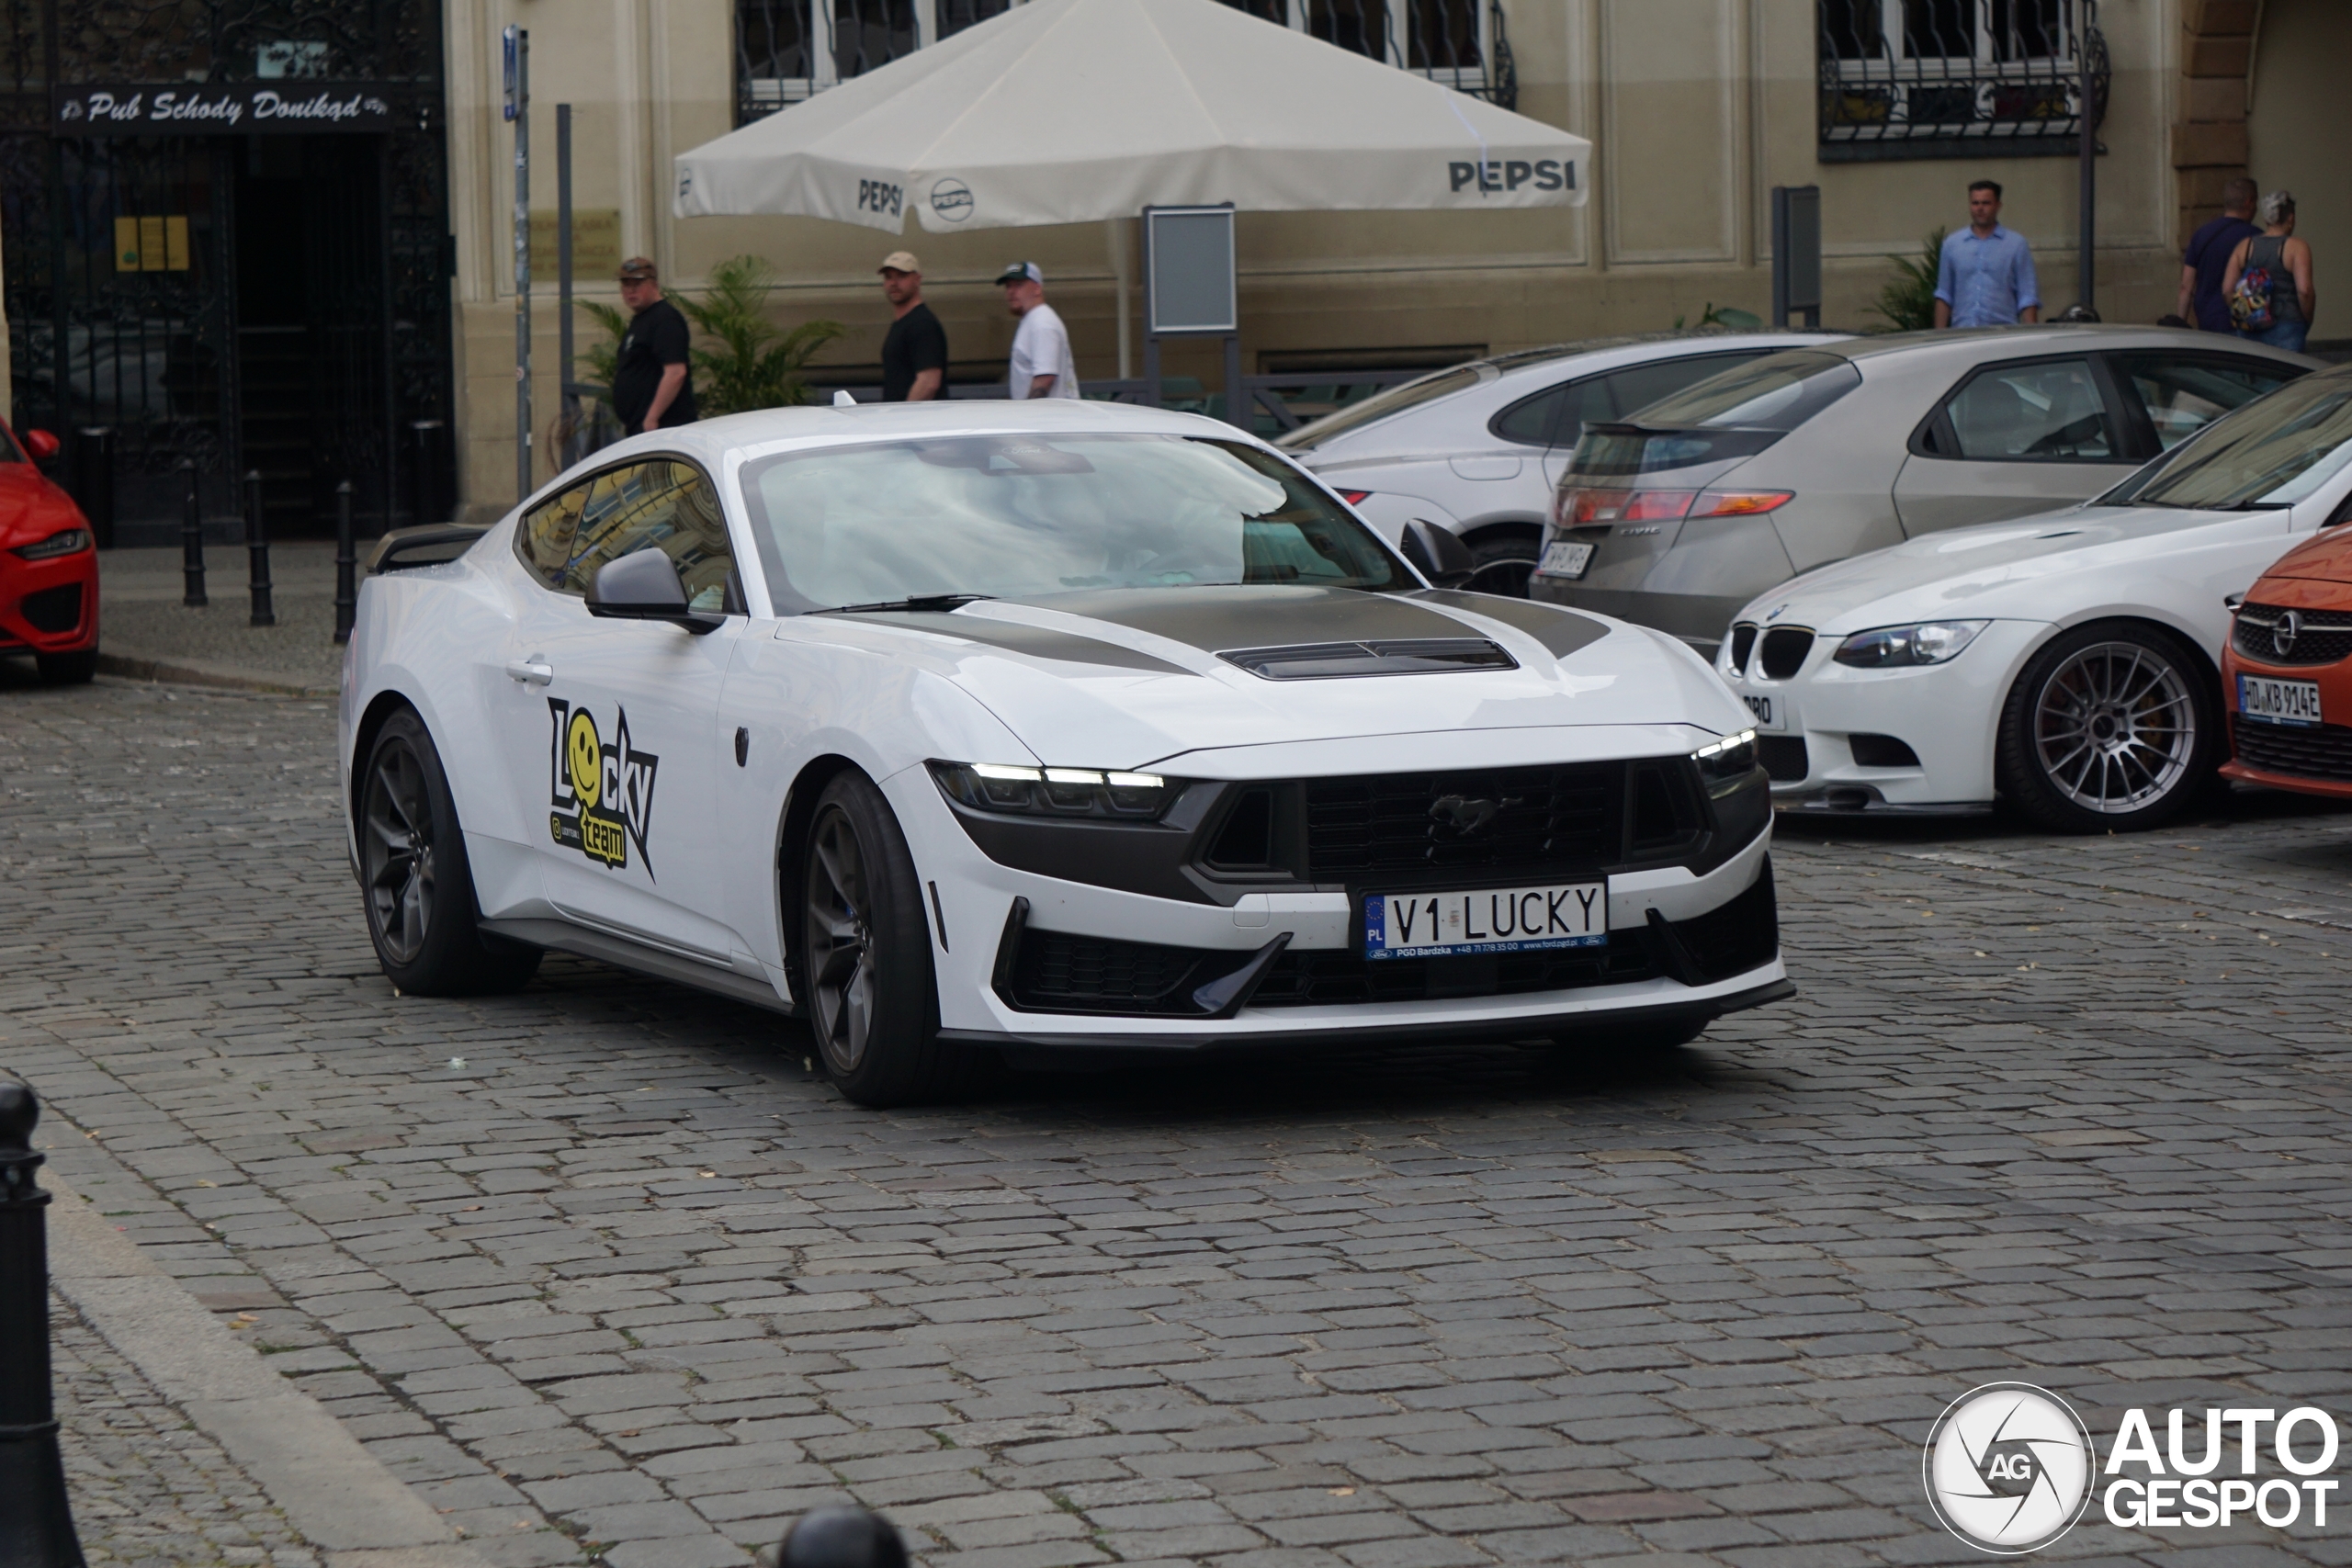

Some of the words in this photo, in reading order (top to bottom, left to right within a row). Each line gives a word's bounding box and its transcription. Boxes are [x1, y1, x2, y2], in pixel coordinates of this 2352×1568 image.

[88, 93, 141, 121] Pub
[151, 94, 243, 126] Schody
[253, 92, 363, 122] Donikąd
[1449, 160, 1577, 193] PEPSI
[858, 179, 903, 218] PEPSI
[1620, 526, 1661, 536] CIVIC
[2244, 681, 2260, 710] HD
[2265, 682, 2282, 713] KB
[2283, 684, 2320, 716] 914E
[583, 815, 624, 858] team
[1393, 897, 1440, 943] V1
[1464, 887, 1598, 940] LUCKY
[1367, 930, 1384, 942] PL
[1396, 948, 1416, 957] PGD
[1417, 946, 1452, 956] Bardzka
[1456, 945, 1472, 953] +48
[1497, 942, 1507, 952] 35
[1507, 942, 1519, 951] 00
